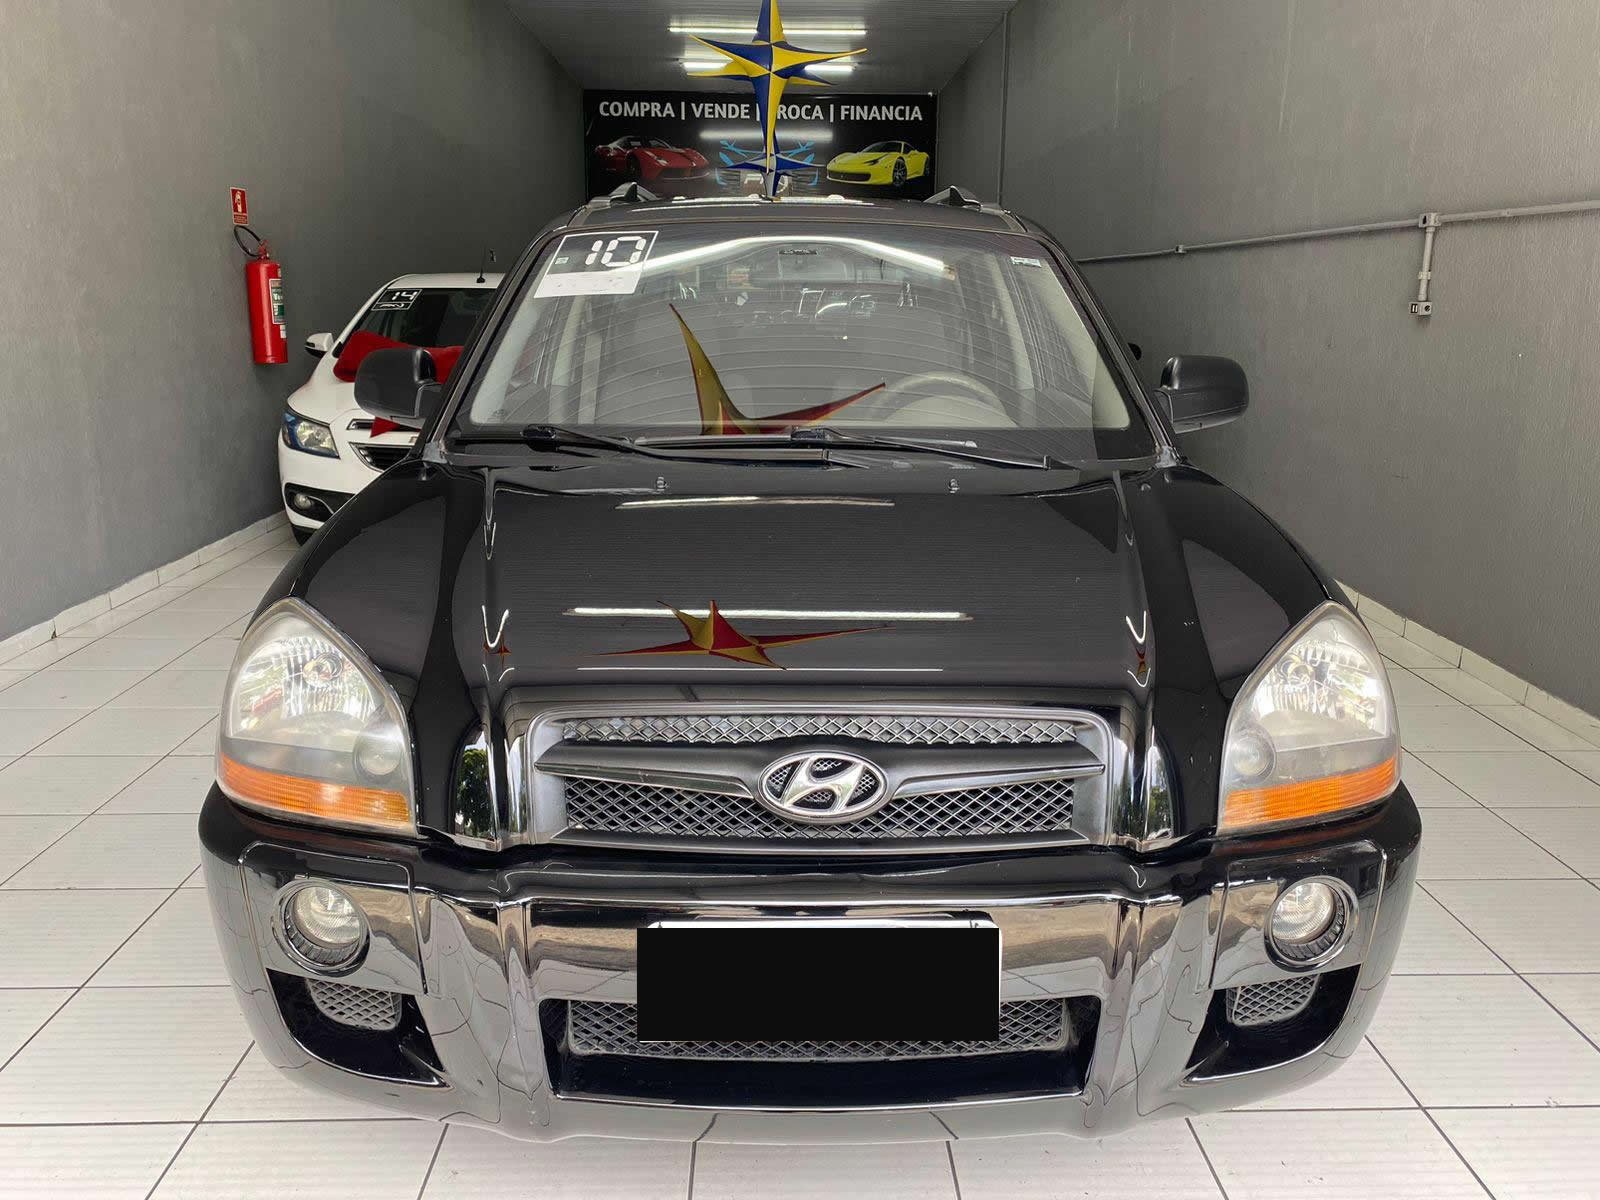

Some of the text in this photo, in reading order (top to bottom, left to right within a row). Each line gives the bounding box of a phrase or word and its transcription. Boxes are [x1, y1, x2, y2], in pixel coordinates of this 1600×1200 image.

[599, 101, 676, 118] COMPRA
[691, 103, 751, 119] VENDE
[776, 104, 824, 120] ROCA
[840, 105, 923, 121] FINANCIA
[585, 235, 647, 268] 10
[391, 291, 418, 301] 14
